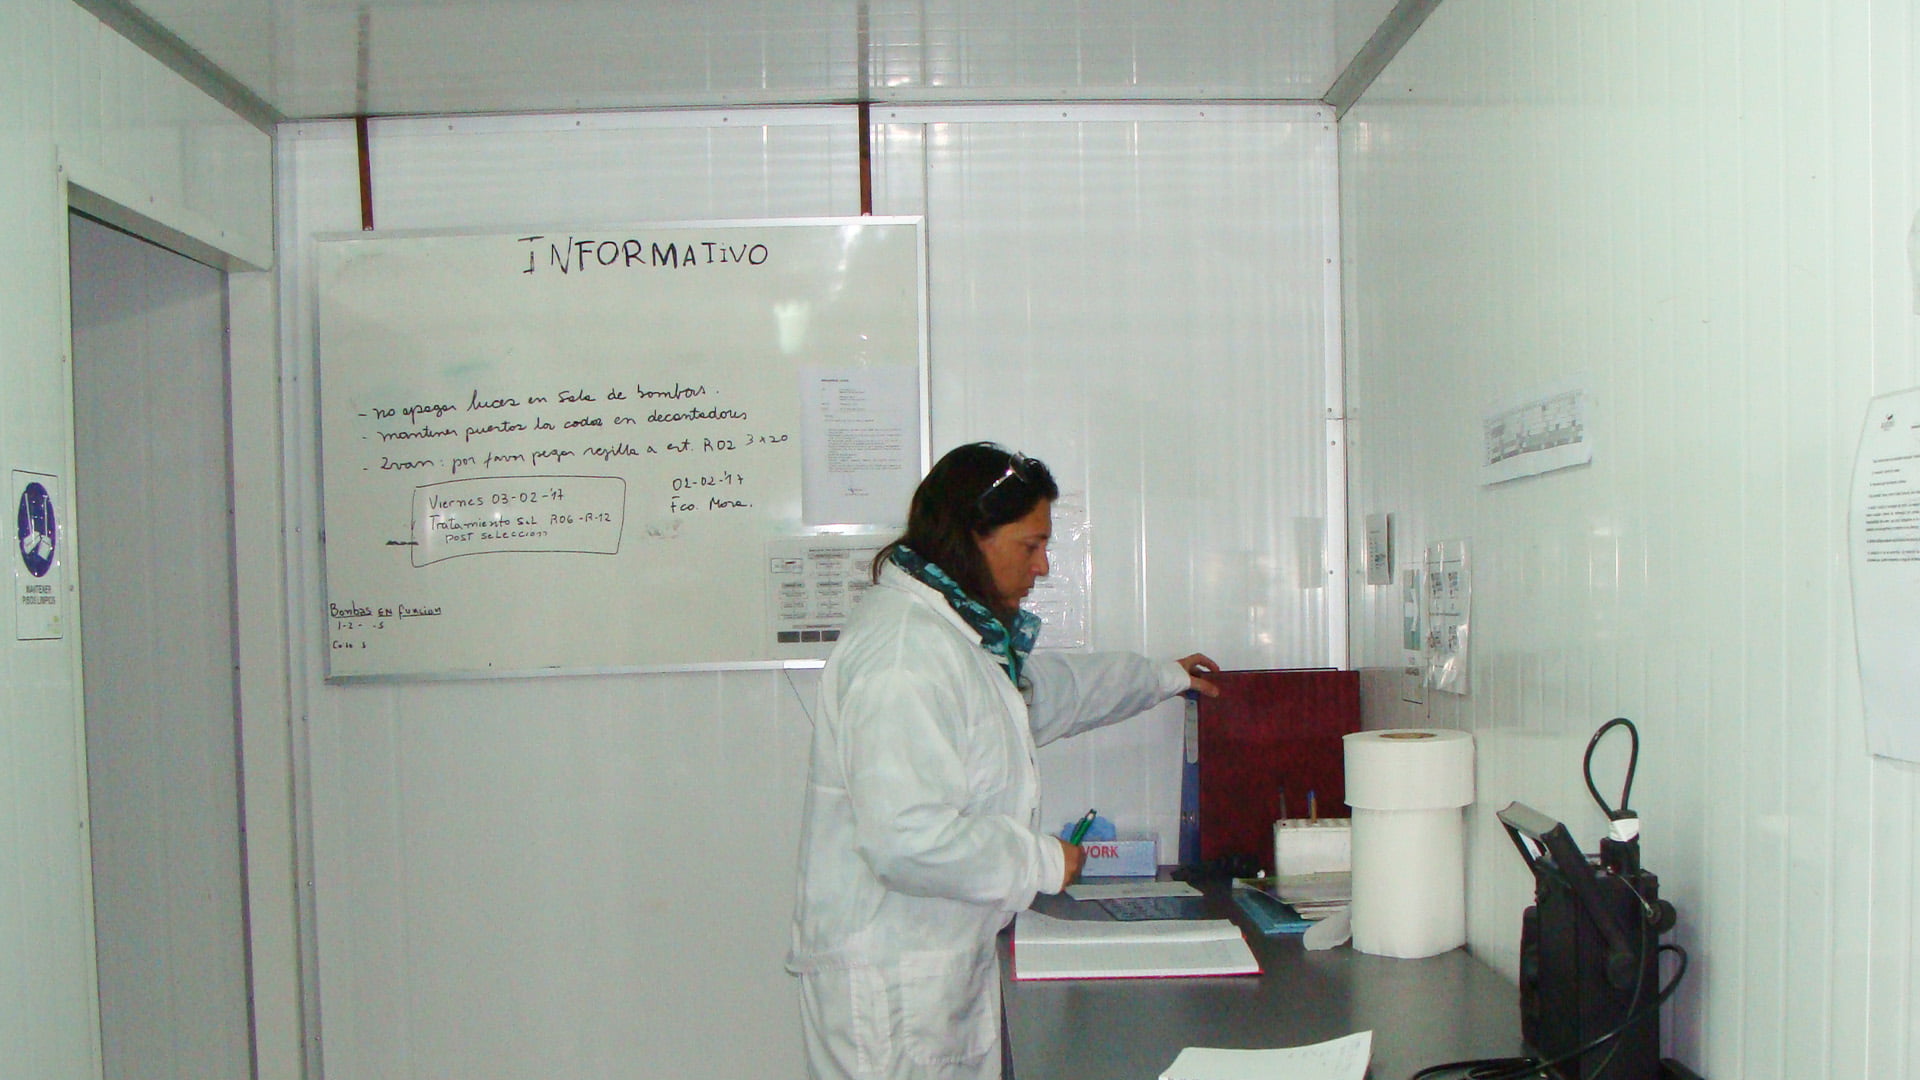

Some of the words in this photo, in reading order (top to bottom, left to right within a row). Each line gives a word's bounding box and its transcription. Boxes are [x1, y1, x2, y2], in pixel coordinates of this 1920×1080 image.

[373, 407, 396, 420] no
[467, 389, 520, 412] luces
[528, 396, 547, 404] en
[607, 387, 627, 400] de
[614, 415, 636, 425] en
[452, 457, 475, 474] por
[484, 451, 525, 468] favor
[428, 494, 484, 509] Viernes
[429, 514, 511, 531] Tratamiento
